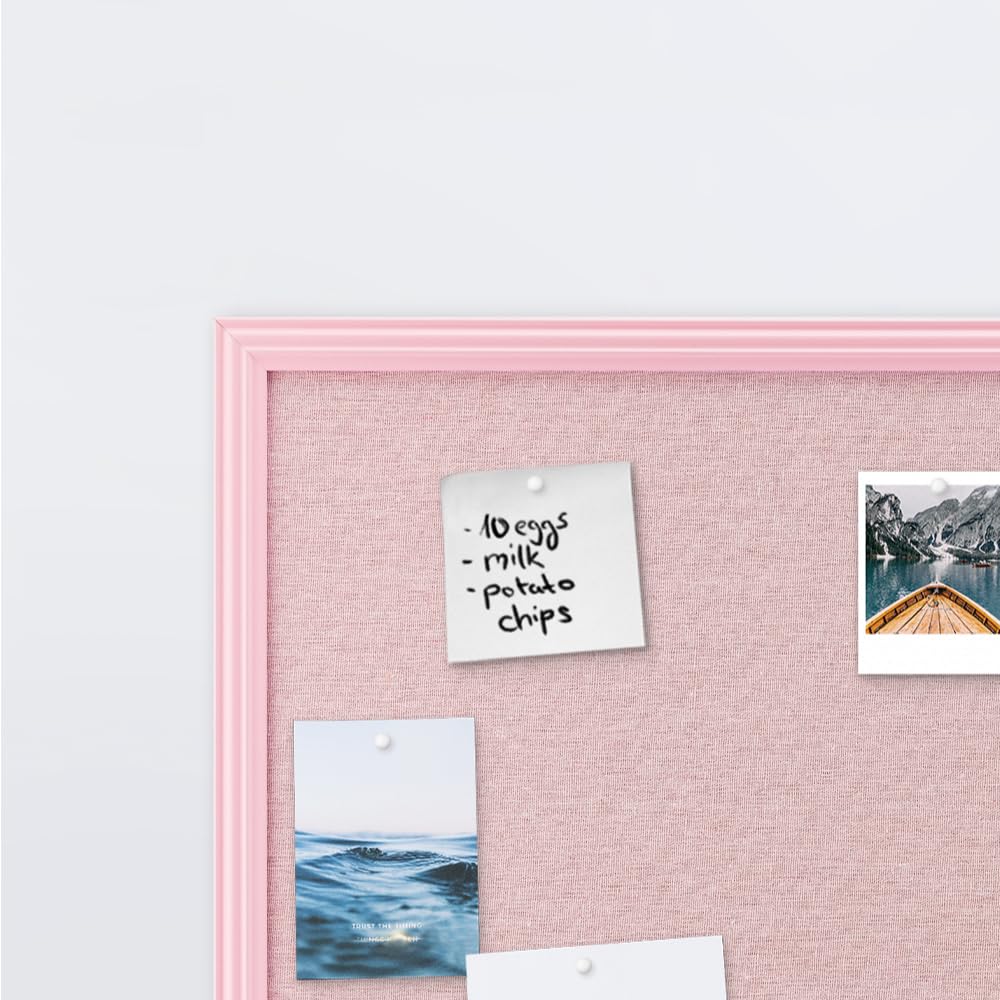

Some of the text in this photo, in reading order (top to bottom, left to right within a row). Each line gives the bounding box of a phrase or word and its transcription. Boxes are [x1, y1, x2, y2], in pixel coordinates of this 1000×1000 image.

[480, 513, 510, 539] 10
[514, 512, 568, 551] eggs
[484, 543, 545, 572] milk
[483, 573, 576, 610] potato
[498, 604, 573, 636] chips
